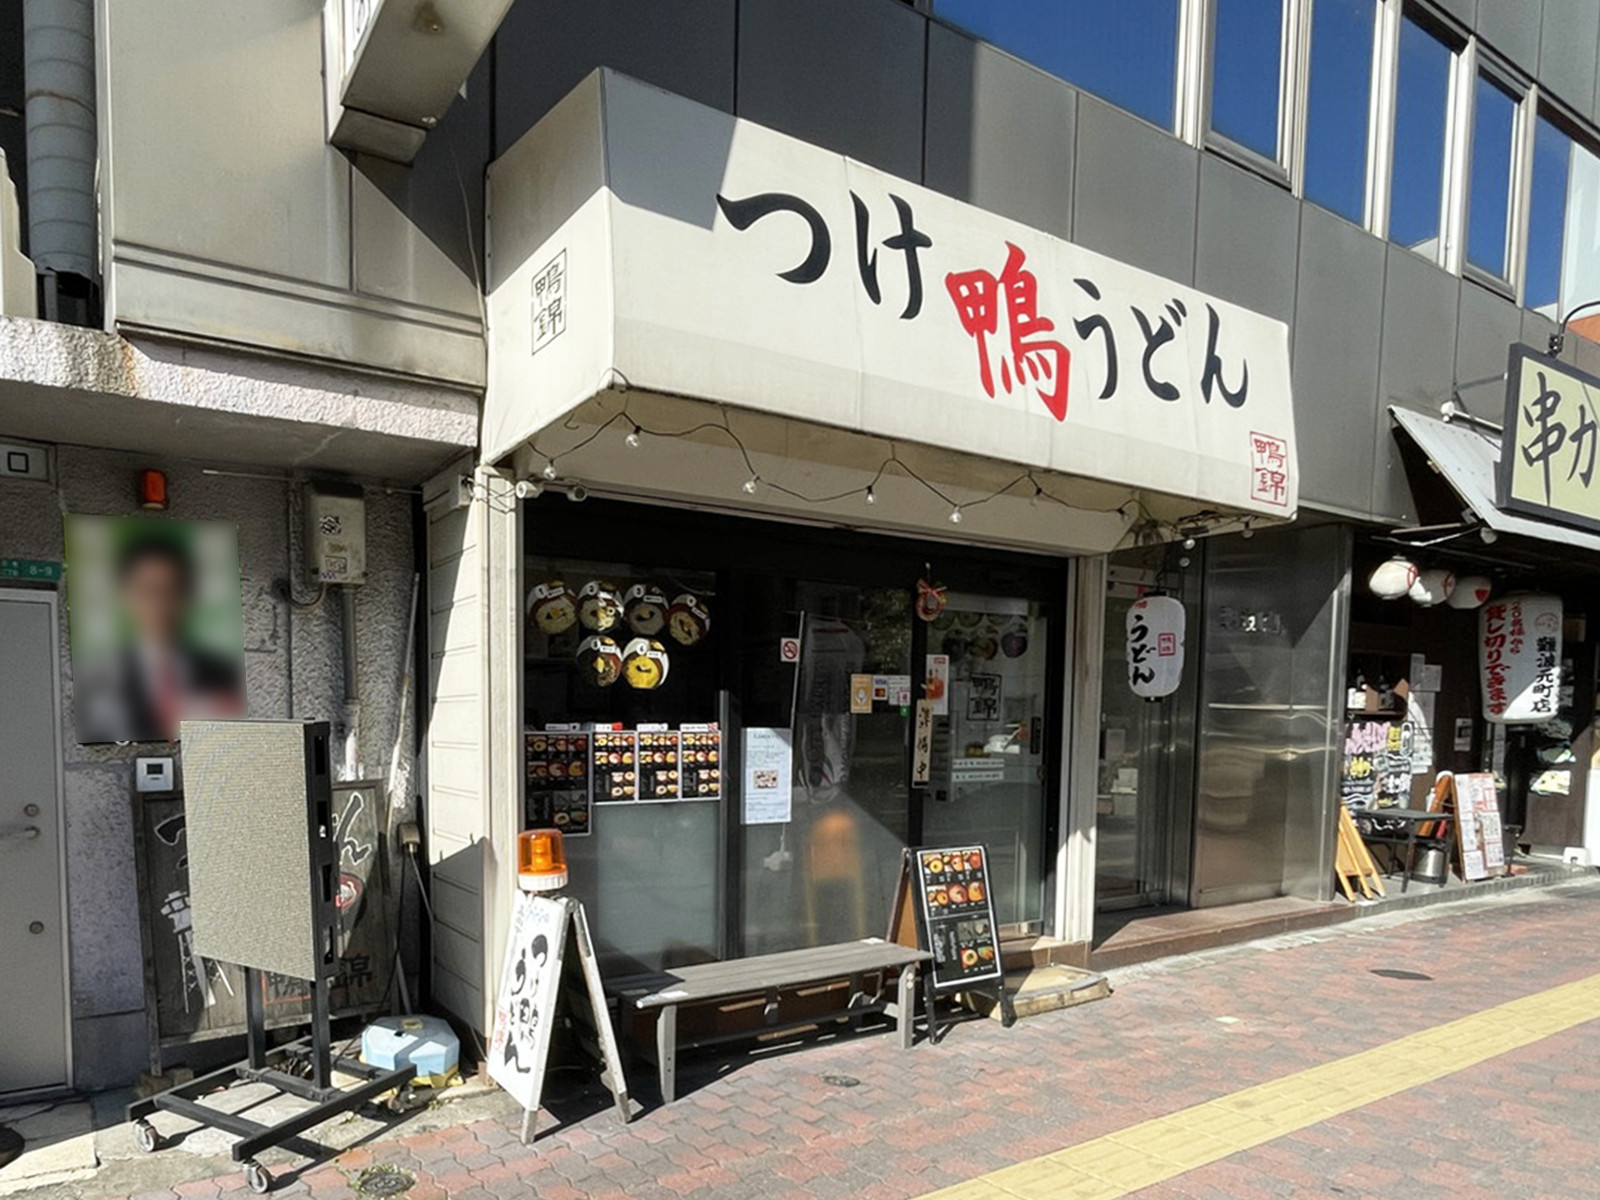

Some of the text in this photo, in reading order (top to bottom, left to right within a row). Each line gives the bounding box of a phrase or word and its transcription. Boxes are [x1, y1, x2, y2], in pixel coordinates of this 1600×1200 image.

[716, 189, 1248, 422] つけ鴨うどん
[1521, 371, 1598, 506] 串カ
[1131, 614, 1157, 686] うどん
